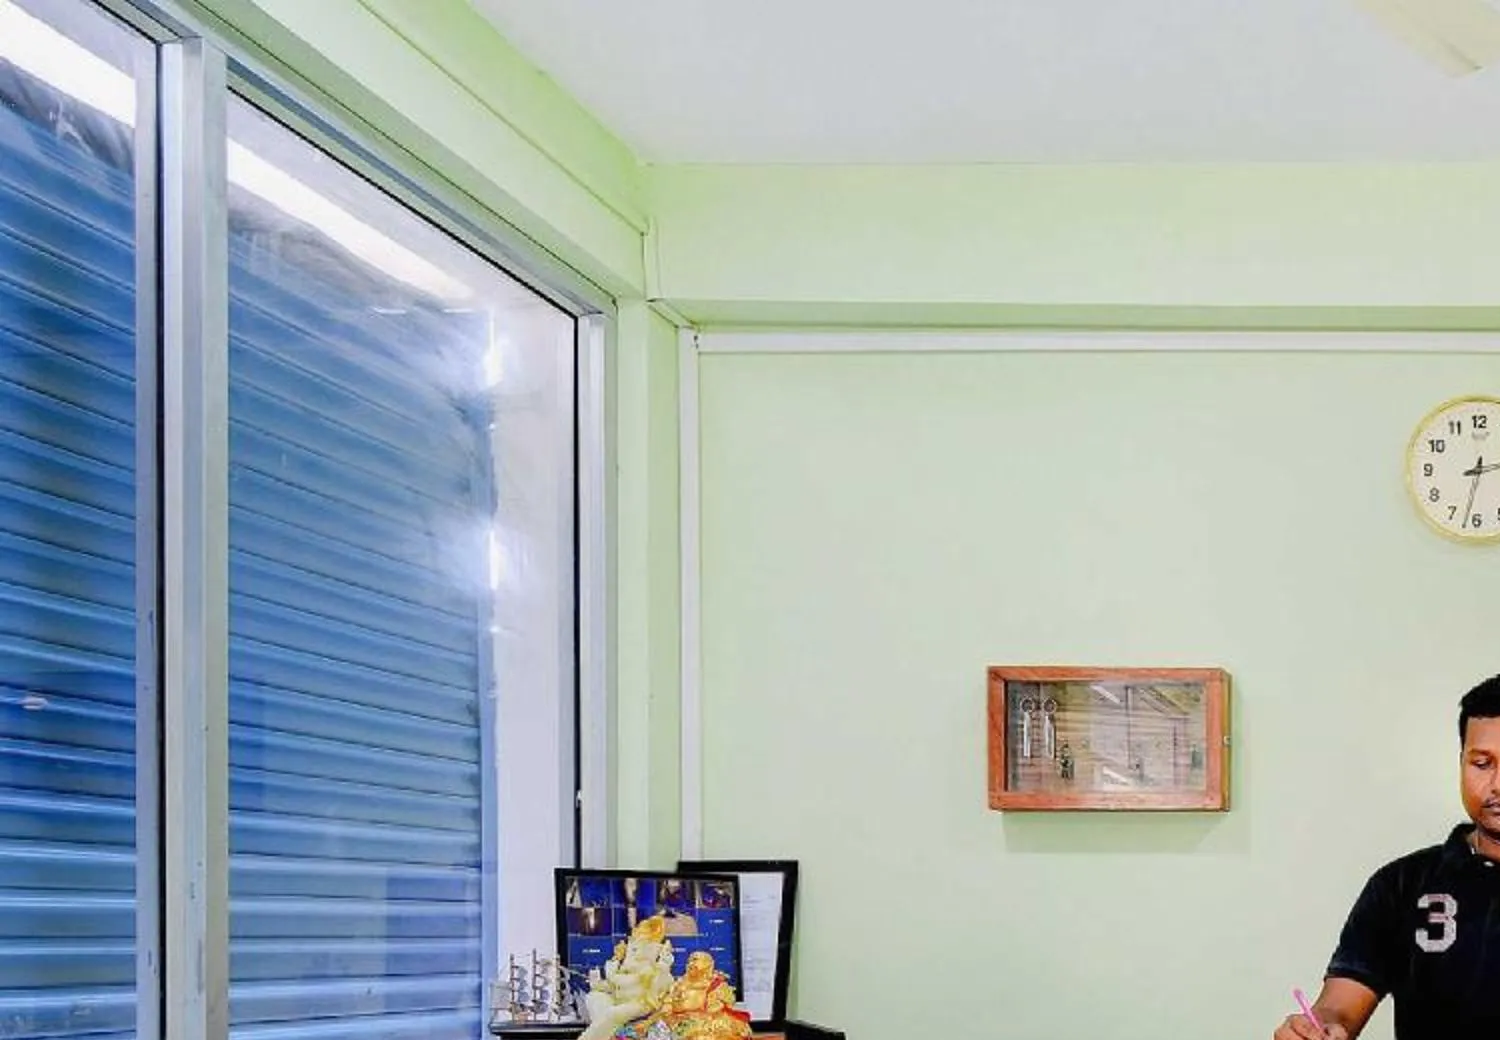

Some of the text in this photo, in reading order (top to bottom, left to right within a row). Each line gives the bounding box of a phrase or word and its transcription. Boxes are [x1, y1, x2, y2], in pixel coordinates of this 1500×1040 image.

[1448, 420, 1461, 435] 11
[1471, 415, 1487, 428] 12
[1428, 440, 1445, 453] 10
[1423, 463, 1433, 477] 9
[1429, 488, 1440, 502] 8
[1448, 506, 1457, 520] 7
[1471, 513, 1482, 528] 6
[1415, 893, 1458, 953] 3
